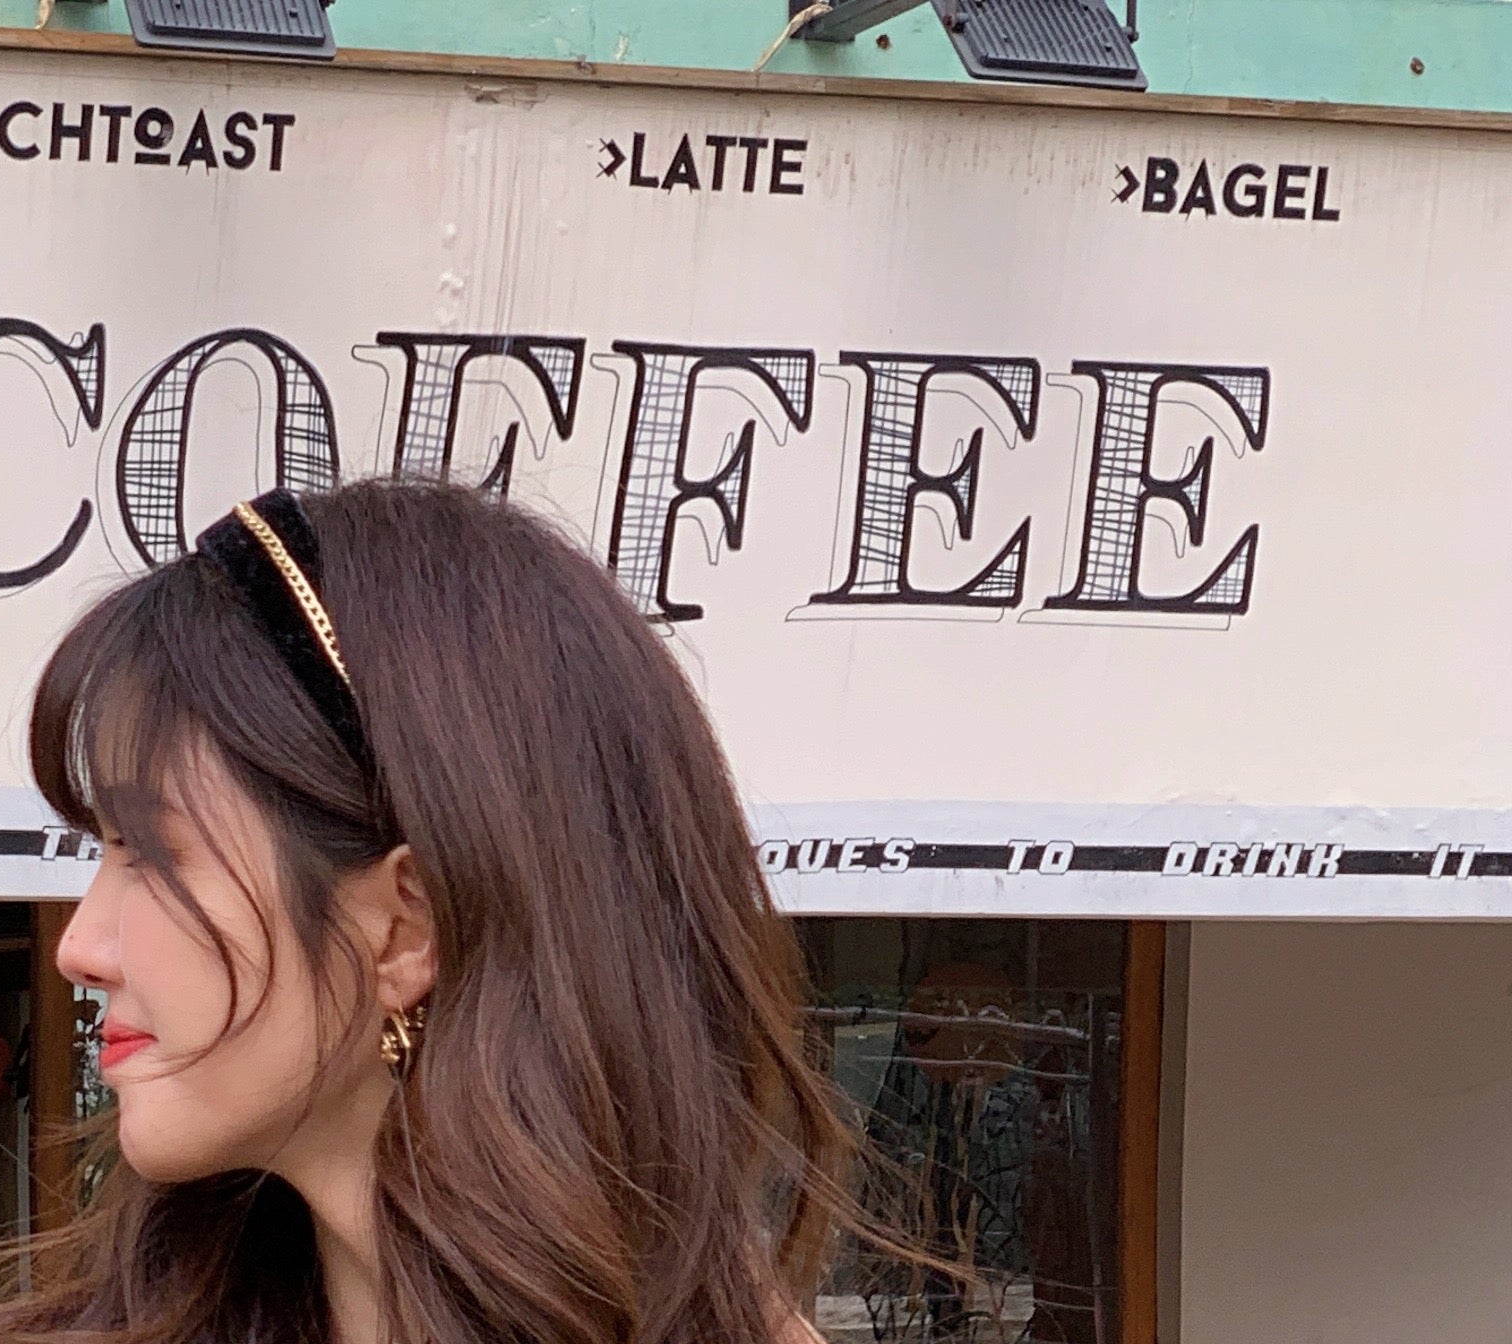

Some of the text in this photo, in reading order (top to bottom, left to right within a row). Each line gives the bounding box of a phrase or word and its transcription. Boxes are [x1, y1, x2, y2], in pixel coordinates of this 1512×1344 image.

[629, 131, 809, 195] LATTE
[1141, 156, 1341, 222] BAGEL
[758, 837, 1486, 880] OVES TO DRINK IT
